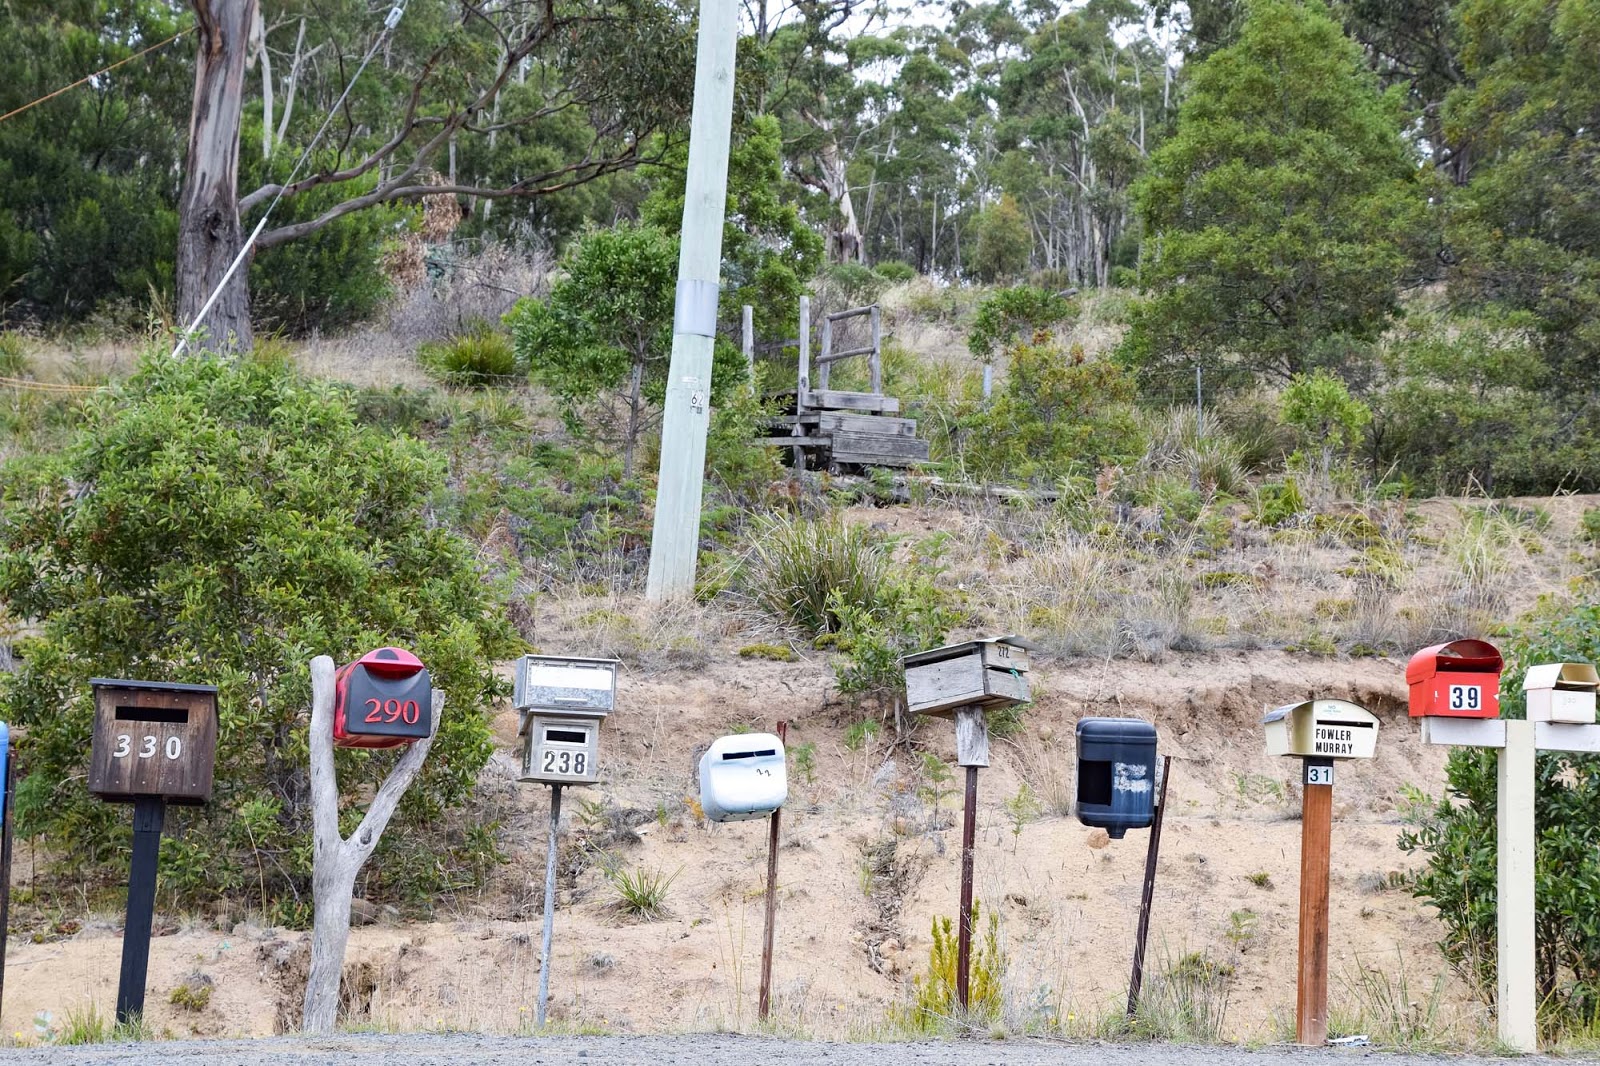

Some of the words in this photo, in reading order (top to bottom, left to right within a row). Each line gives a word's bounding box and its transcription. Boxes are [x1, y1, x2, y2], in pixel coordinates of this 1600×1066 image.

[1452, 686, 1478, 709] 39
[364, 698, 420, 726] 290
[1315, 728, 1352, 741] FOWLER
[113, 734, 181, 760] 330
[1315, 741, 1353, 754] MURRAY
[543, 750, 586, 775] 238
[1310, 768, 1329, 782] 31
